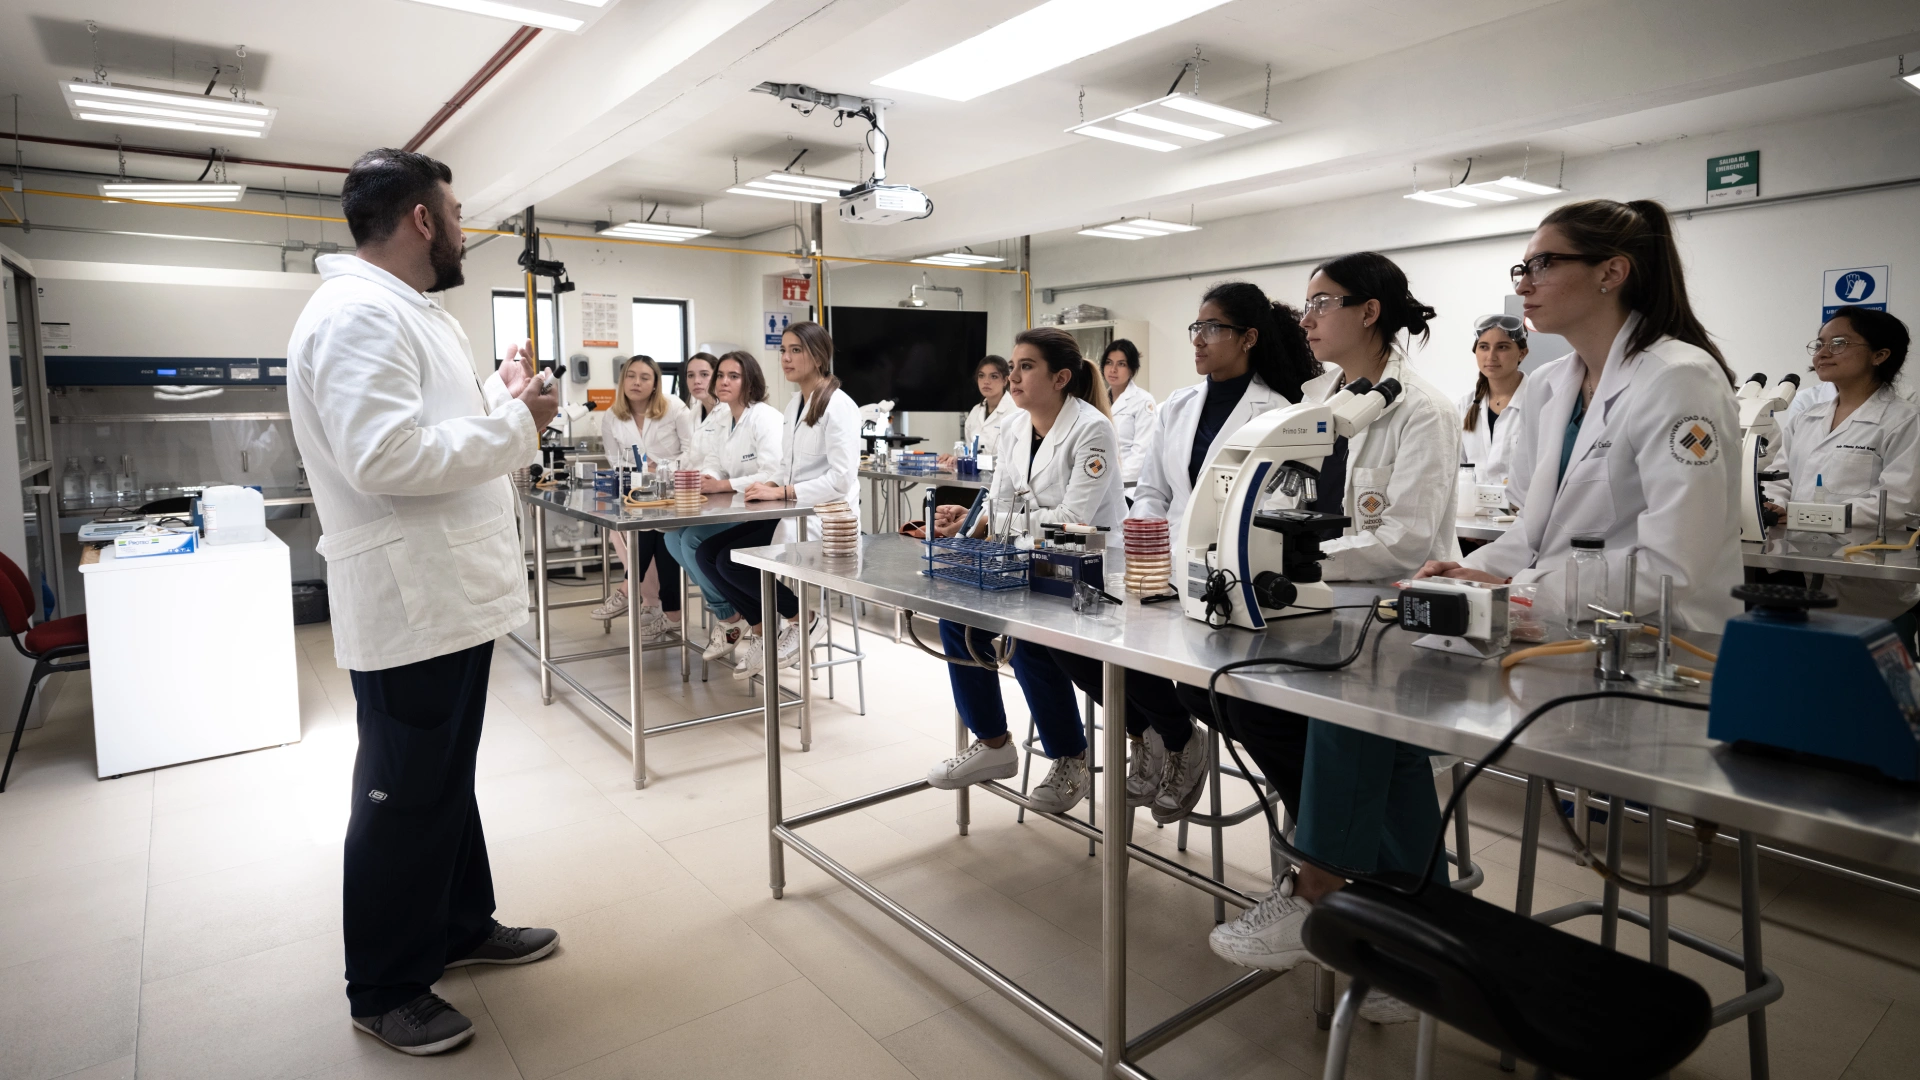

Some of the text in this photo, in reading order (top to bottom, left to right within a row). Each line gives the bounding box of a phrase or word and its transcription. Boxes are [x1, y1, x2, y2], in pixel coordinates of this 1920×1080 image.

[1719, 156, 1738, 165] SALIDA
[1715, 162, 1750, 173] EMERGENCIA
[1282, 427, 1297, 435] Primo
[1669, 415, 1699, 448] UNIVERSIDAD
